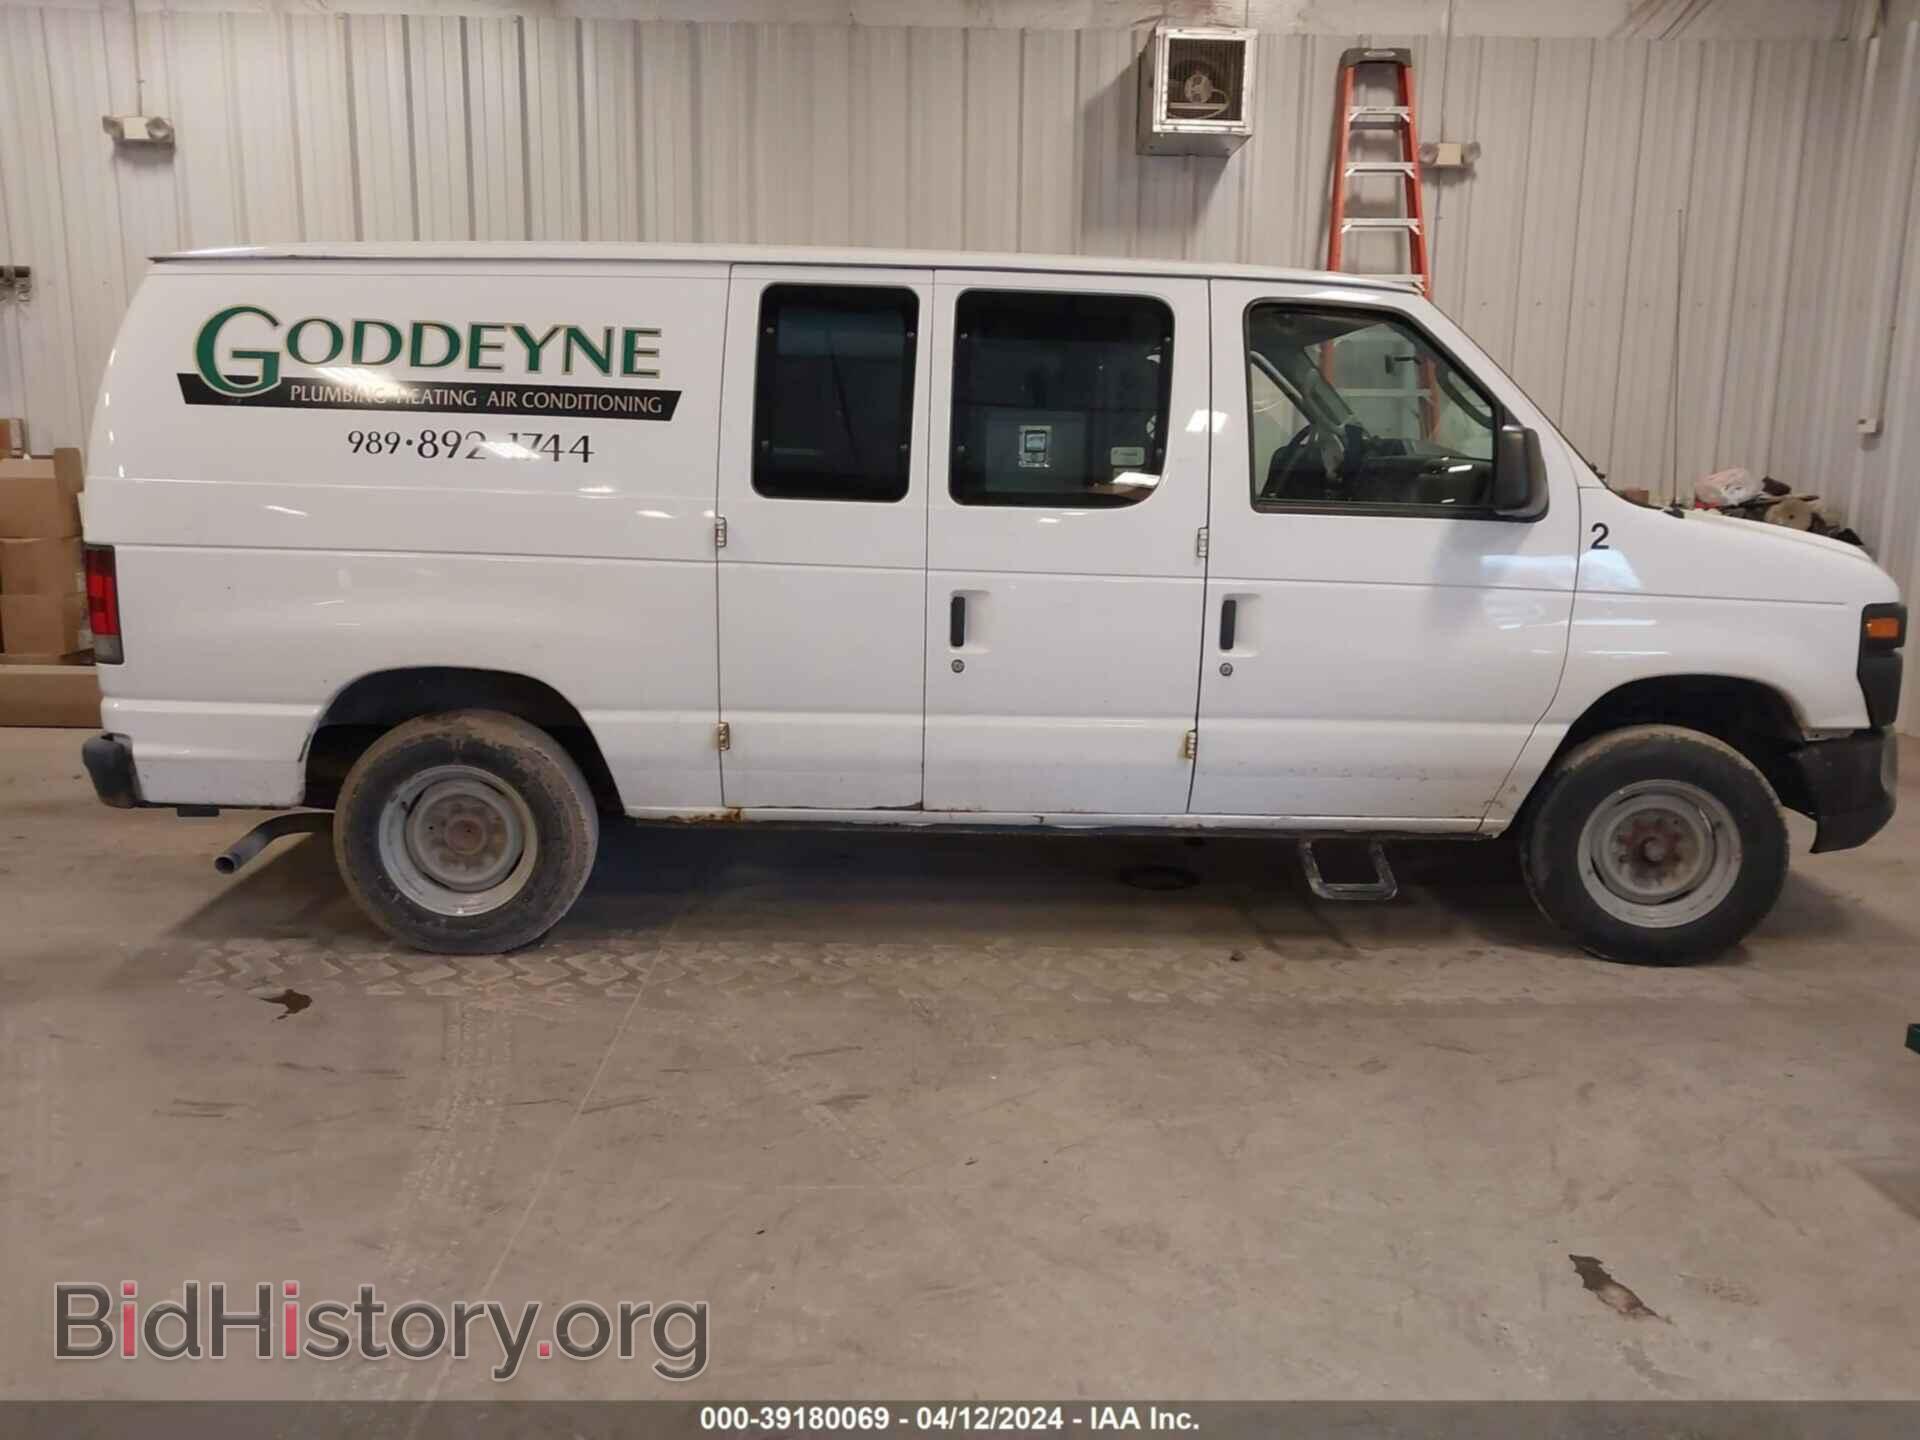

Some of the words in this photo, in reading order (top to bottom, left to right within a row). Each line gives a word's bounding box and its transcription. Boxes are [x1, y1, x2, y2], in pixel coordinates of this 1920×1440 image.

[194, 304, 662, 398] GODDEYNE
[290, 384, 387, 405] PLUMBING
[396, 387, 477, 408] HEATING
[486, 390, 518, 409] AIR
[521, 391, 663, 414] CONDITIONING
[1591, 522, 1610, 550] 2
